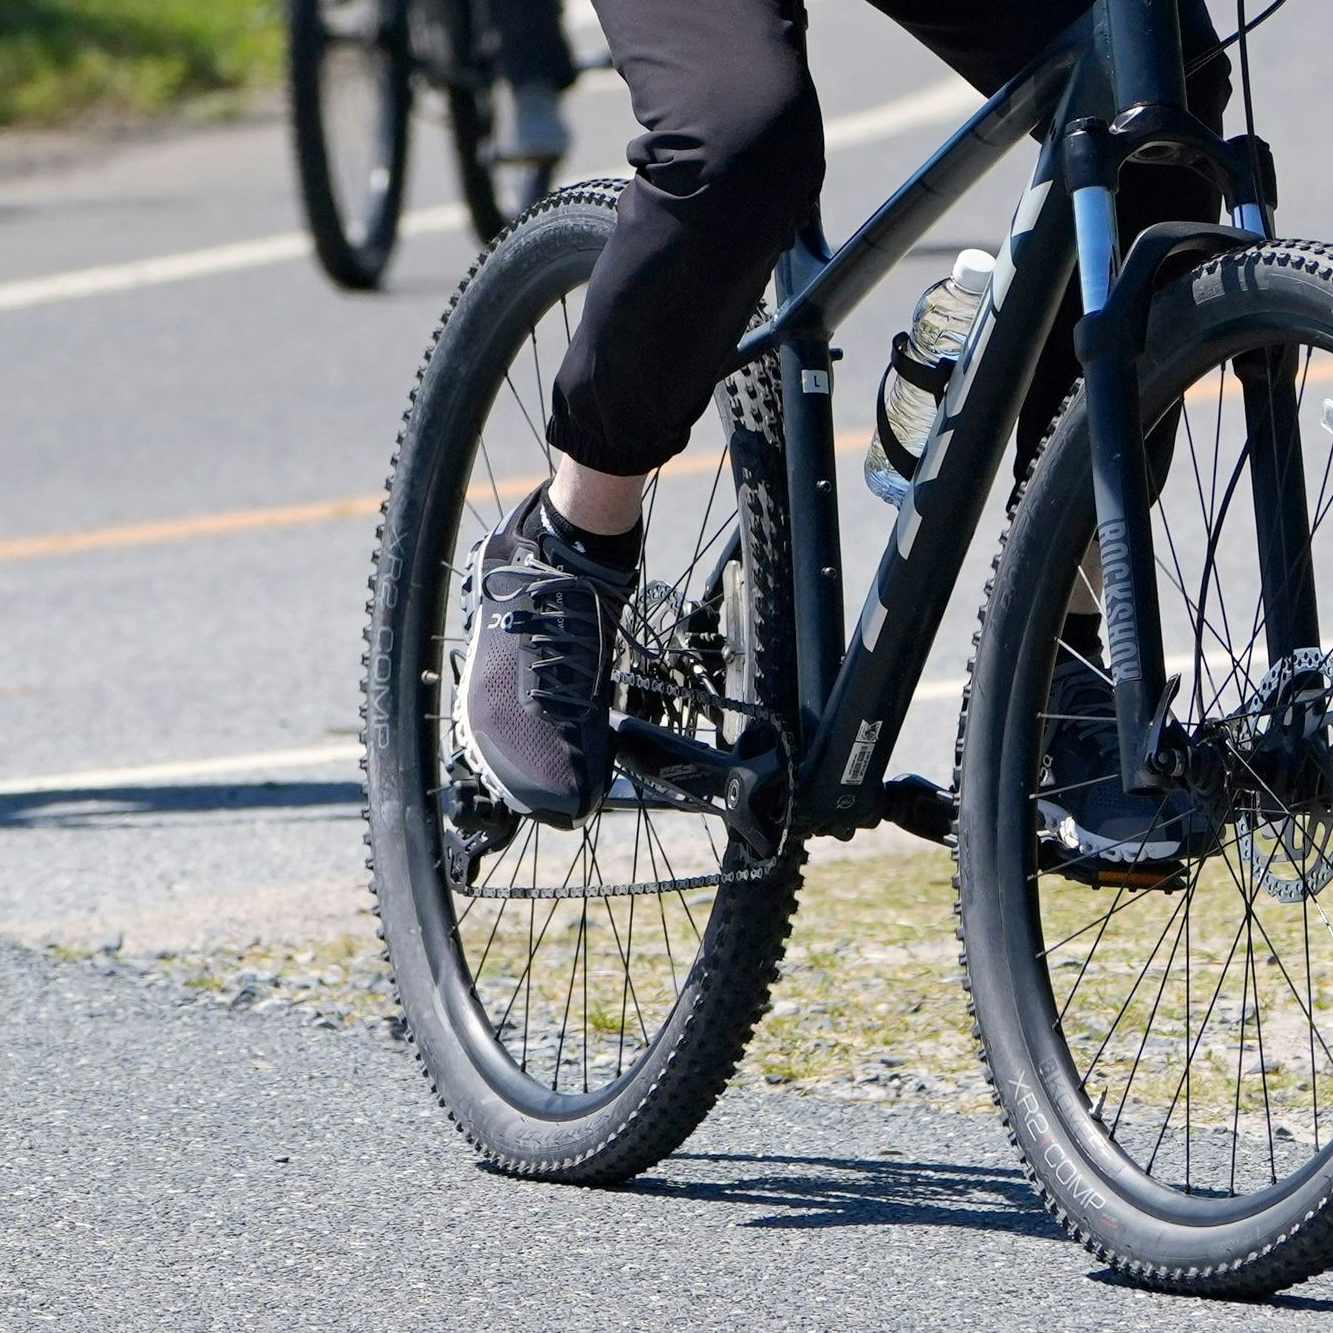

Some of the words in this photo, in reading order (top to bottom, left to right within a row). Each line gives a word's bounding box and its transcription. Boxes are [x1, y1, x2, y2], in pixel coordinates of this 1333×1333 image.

[813, 375, 821, 388] L
[369, 626, 395, 750] COMP
[1008, 1070, 1049, 1141] XR2
[1044, 1144, 1107, 1210] COMP
